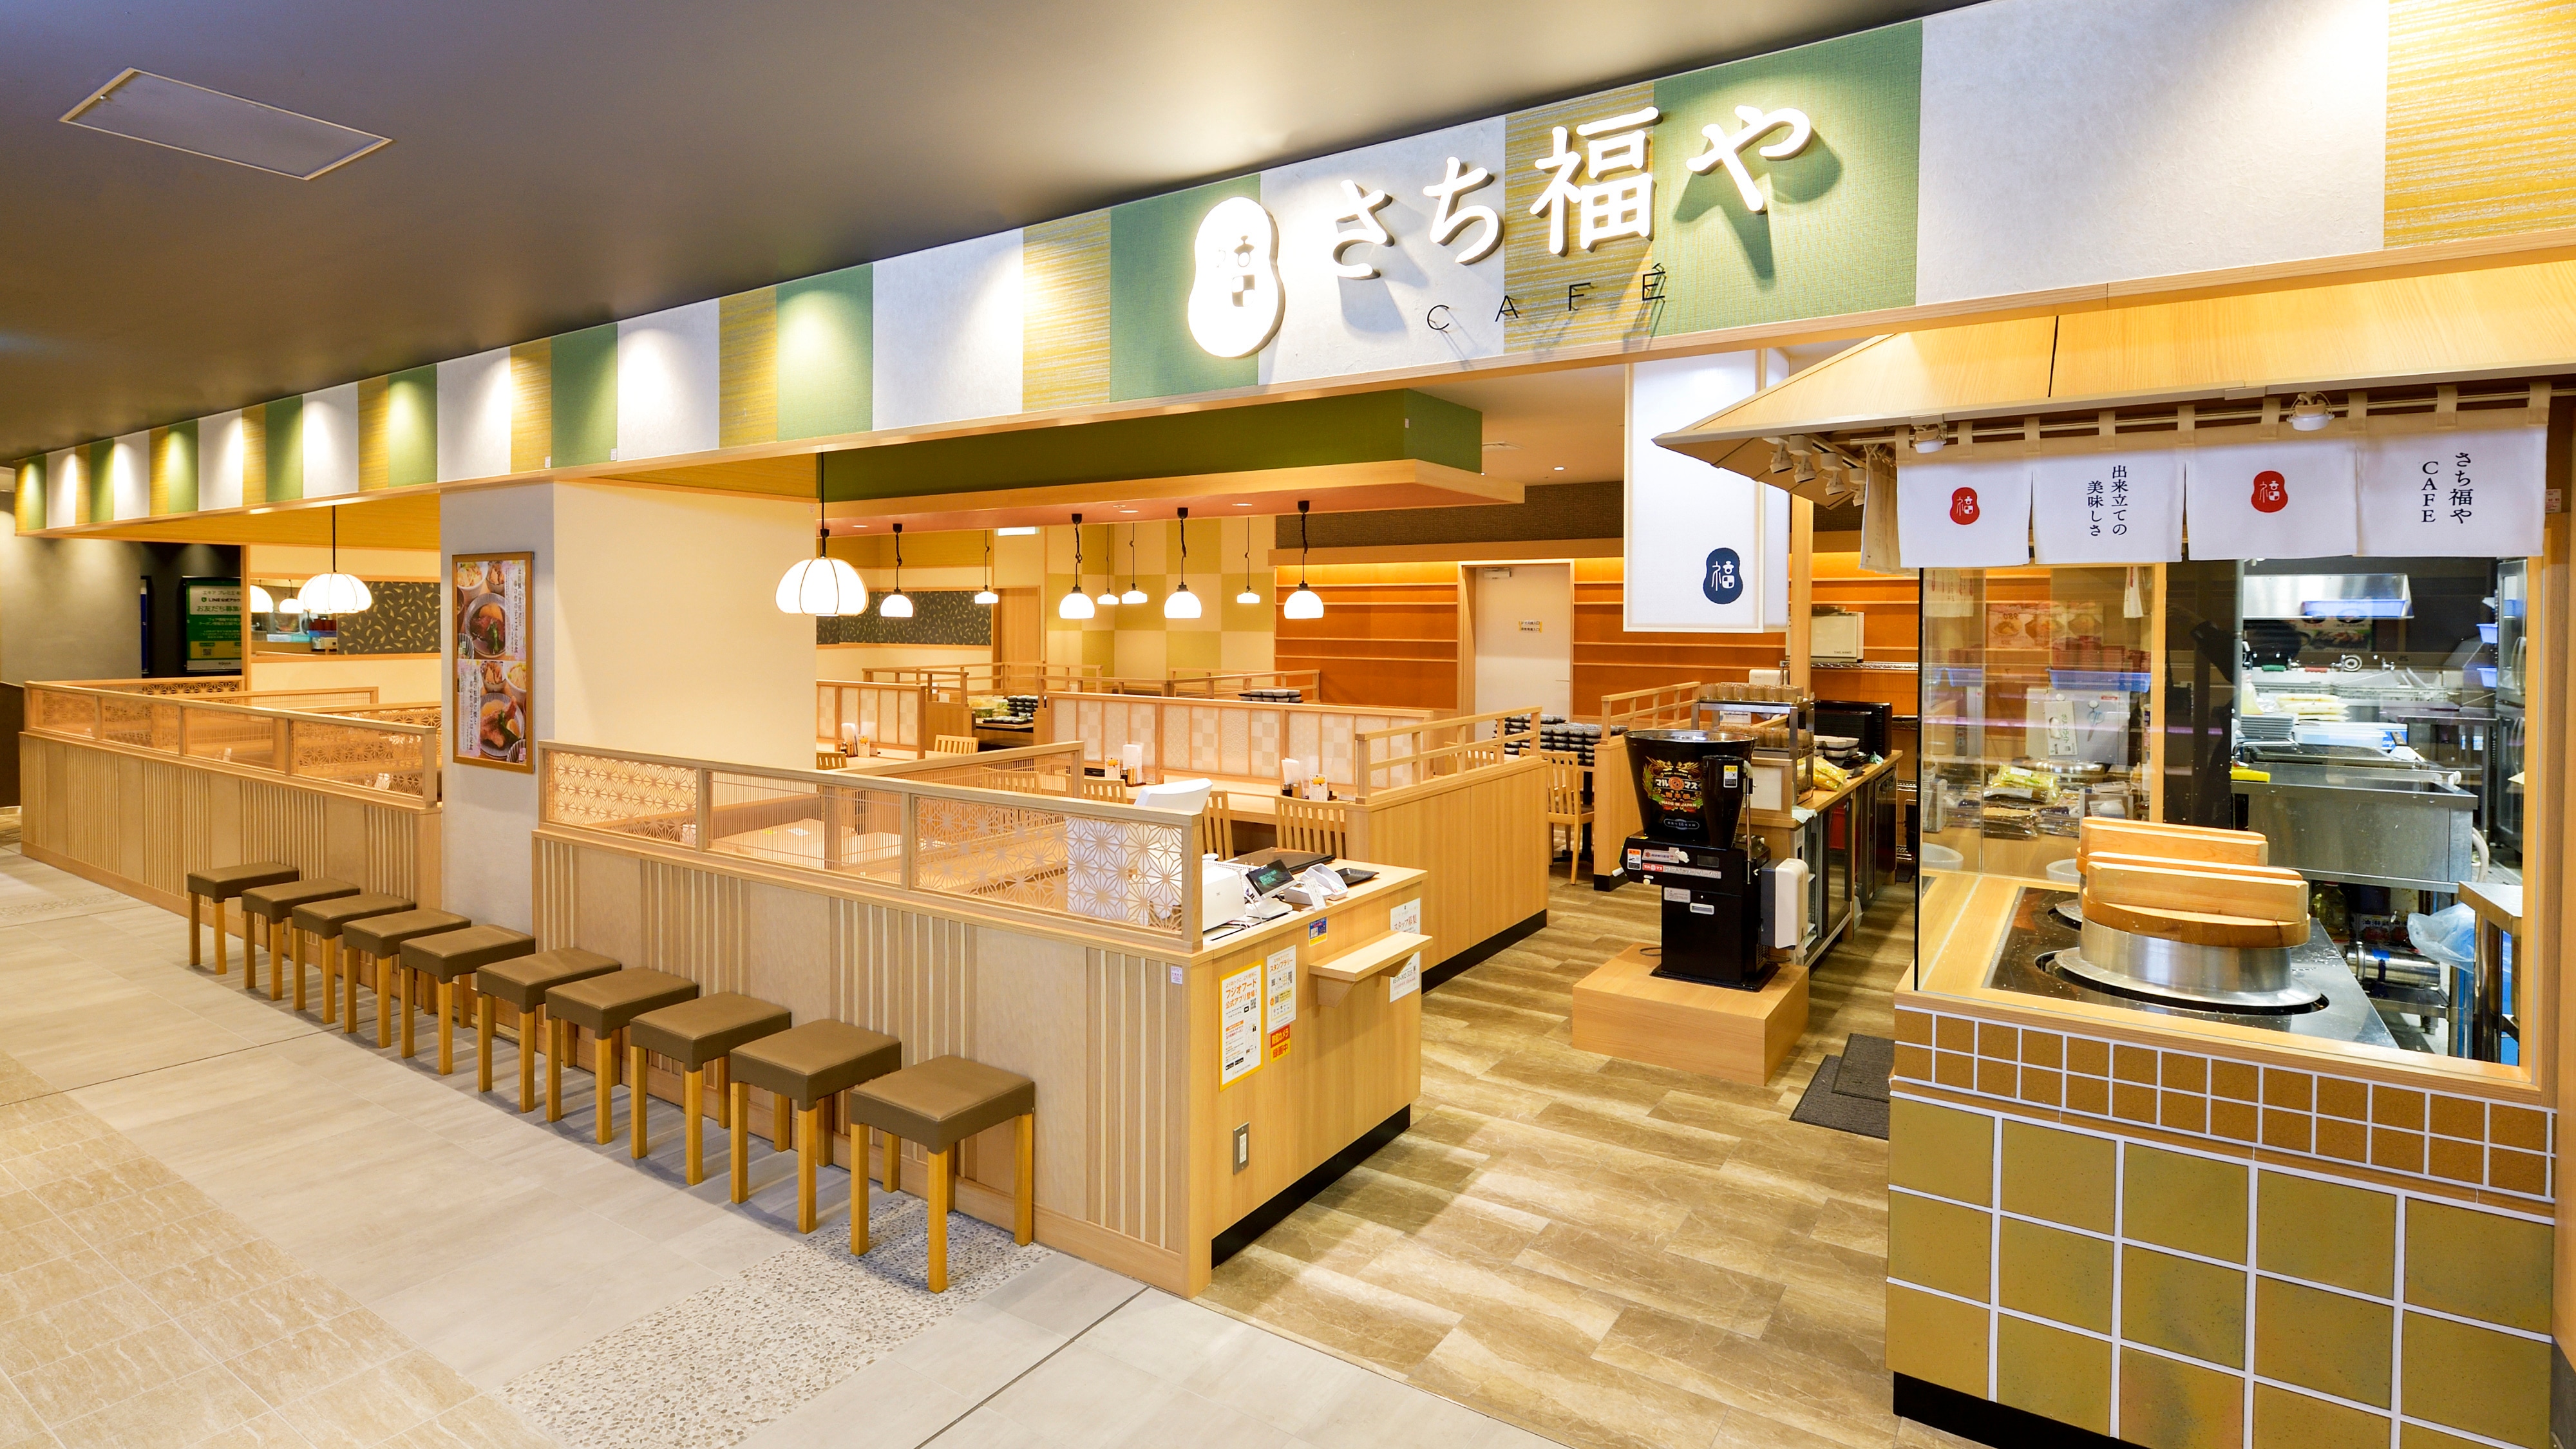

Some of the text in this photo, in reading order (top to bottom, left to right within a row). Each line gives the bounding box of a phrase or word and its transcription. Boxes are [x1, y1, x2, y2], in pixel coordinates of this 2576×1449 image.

[1333, 104, 1814, 281] さち福や
[1426, 262, 1666, 331] CAFÉ
[2086, 480, 2105, 536] 美味しさ
[2110, 464, 2129, 536] 出来立ての
[2421, 460, 2439, 523] CAFE
[2448, 451, 2474, 524] さち福や
[1655, 779, 1669, 787] マル
[1394, 914, 1417, 931] スタッフ募集
[1226, 978, 1257, 999] フジオフード
[1269, 958, 1294, 972] スタンプラリー
